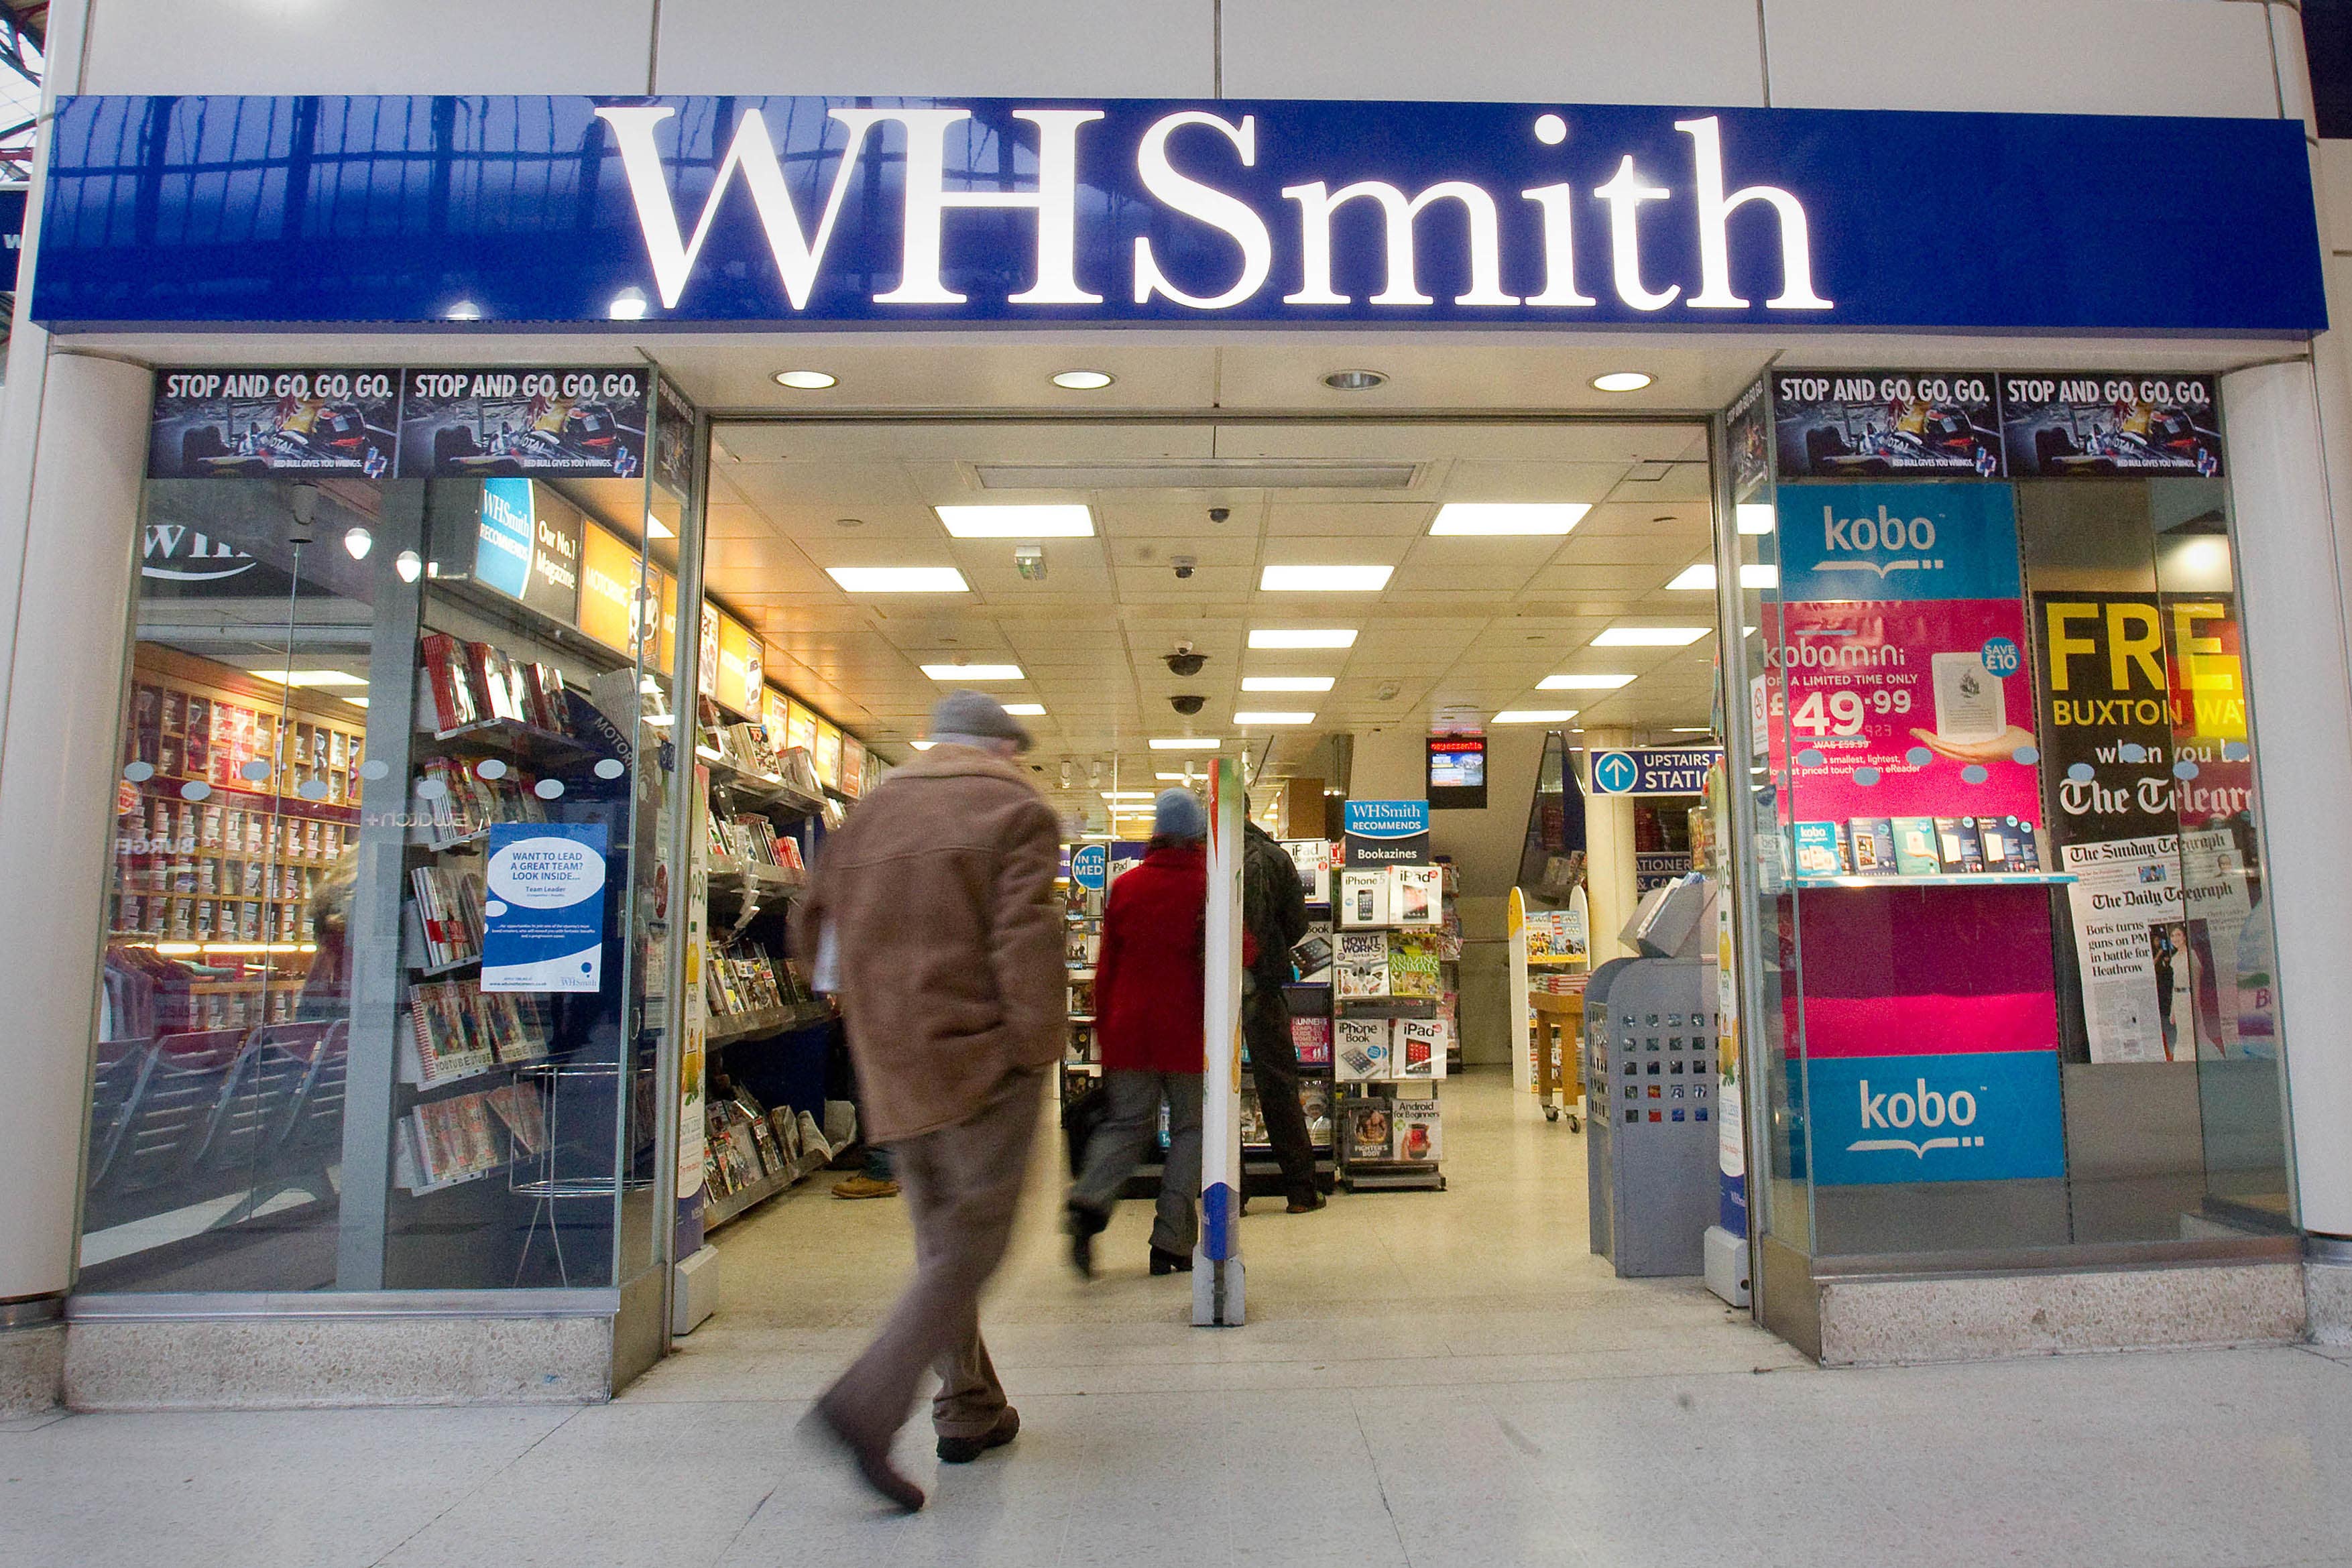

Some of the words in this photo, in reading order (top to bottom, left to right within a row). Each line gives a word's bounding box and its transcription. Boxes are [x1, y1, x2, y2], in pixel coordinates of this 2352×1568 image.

[595, 107, 1834, 312] WHSmith
[167, 375, 221, 398] STOP
[223, 375, 269, 398] AND
[275, 375, 312, 401] GO,
[315, 375, 352, 401] GO,
[355, 375, 394, 398] GO.
[415, 374, 469, 398] STOP
[471, 374, 517, 398] AND
[522, 374, 559, 401] GO,
[563, 375, 600, 401] GO,
[603, 375, 640, 398] GO.
[1781, 378, 1830, 402] STOP
[1833, 379, 1875, 402] AND
[1880, 379, 1915, 405] GO,
[1918, 379, 1952, 405] GO,
[1955, 380, 1990, 402] GO.
[2008, 380, 2054, 402] STOP
[2059, 380, 2099, 403] AND
[2104, 381, 2137, 406] GO,
[2140, 381, 2173, 406] GO,
[2176, 382, 2210, 403] GO.
[270, 435, 294, 453] OTAL
[520, 434, 545, 453] OTAL
[1887, 434, 1909, 452] OTAL
[2113, 436, 2135, 453] OTAL
[1918, 459, 1936, 467] GIVES
[1936, 459, 1948, 467] YOU
[483, 489, 529, 538] WHSmith
[1824, 505, 1936, 550] kobo
[479, 522, 528, 562] RECOMMENDS
[538, 520, 556, 548] Our
[556, 530, 576, 560] No.1
[536, 549, 575, 590] Magazine
[1985, 645, 2015, 655] SAVE
[1985, 654, 2017, 670] £10
[1791, 676, 1800, 686] A
[1803, 675, 1850, 686] LIMITED
[1853, 674, 1883, 684] TIME
[1886, 674, 1918, 684] ONLY
[2053, 700, 2182, 726] BUXTON
[2193, 699, 2245, 725] WA
[2095, 739, 2162, 764] wn
[1644, 754, 1710, 766] UPSTAIRS
[1830, 755, 1865, 764] smallest,
[1868, 754, 1901, 764] lightest,
[1802, 766, 1829, 778] priced
[1830, 766, 1855, 774] touch
[1885, 764, 1920, 773] eReader
[2059, 778, 2129, 815] The
[2137, 777, 2252, 821] Telegr
[1352, 804, 1421, 818] WHSmith
[1353, 821, 1421, 831] RECOMMENDS
[1800, 826, 1826, 837] kobo
[1292, 843, 1318, 856] iPad
[1358, 848, 1417, 859] Bookazines
[2070, 847, 2099, 863] The
[2101, 841, 2156, 859] Sunday
[2158, 833, 2225, 854] Teegraph
[512, 852, 540, 860] WANT
[543, 852, 555, 860] TO
[558, 852, 582, 860] LEAD
[1077, 855, 1089, 864] IN
[510, 862, 517, 870] A
[520, 862, 550, 870] GREAT
[552, 862, 583, 870] TEAM?
[1075, 865, 1102, 876] MED
[512, 872, 539, 880] LOOK
[1345, 876, 1378, 886] iPhone
[1400, 869, 1430, 883] iPad
[2092, 894, 2121, 910] The
[2123, 890, 2163, 906] Daily
[2164, 881, 2233, 902] Teegraph
[2086, 923, 2114, 936] Boris
[2116, 922, 2144, 932] turns
[1342, 936, 1369, 945] HOW
[1370, 935, 1380, 945] IT
[2089, 941, 2113, 951] guns
[2115, 938, 2129, 946] on
[2131, 932, 2149, 945] PM
[1343, 944, 1380, 953] WORKS
[2091, 953, 2105, 963] in
[2106, 948, 2133, 961] battle
[2135, 947, 2151, 959] for
[1390, 955, 1439, 965] AMAZING
[1391, 963, 1439, 971] ANIMALS
[2092, 963, 2143, 977] Heathrow
[1339, 1023, 1378, 1034] iPhone
[1403, 1023, 1435, 1037] iPad
[1346, 1034, 1370, 1042] Book
[1399, 1102, 1433, 1111] Android
[1860, 1078, 1977, 1129] kobo
[1405, 1111, 1439, 1120] Beginners
